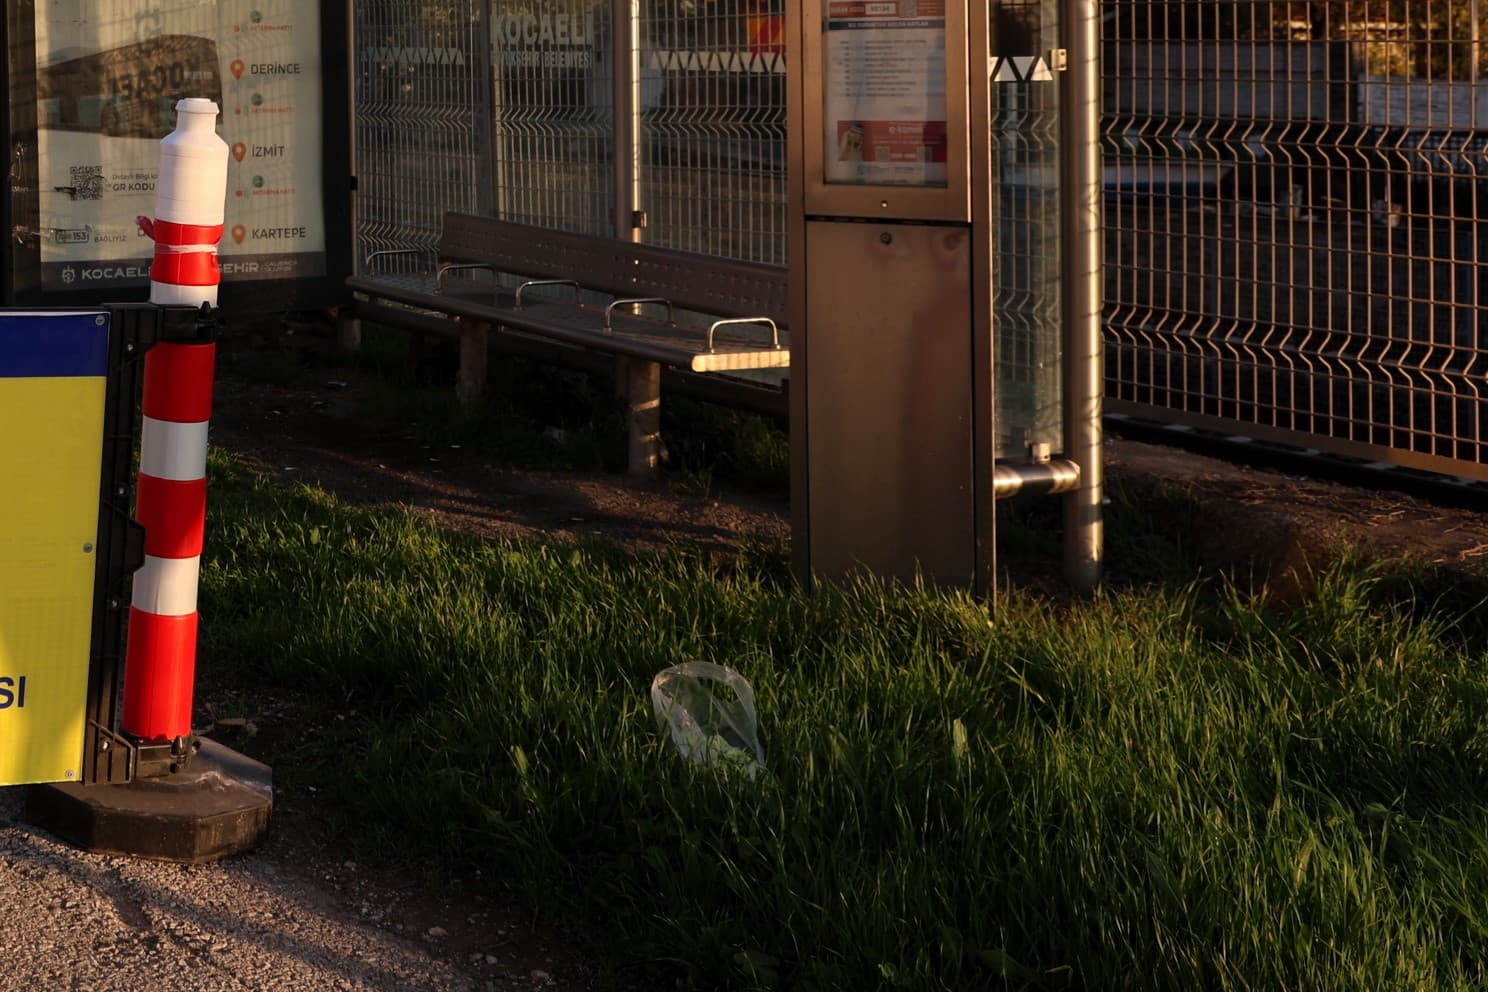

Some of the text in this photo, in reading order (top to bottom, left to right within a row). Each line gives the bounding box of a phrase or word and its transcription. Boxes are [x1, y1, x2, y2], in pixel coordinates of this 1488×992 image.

[250, 61, 301, 75] DERİNCE
[252, 144, 285, 157] İZMİT
[252, 227, 307, 239] KARTEPE
